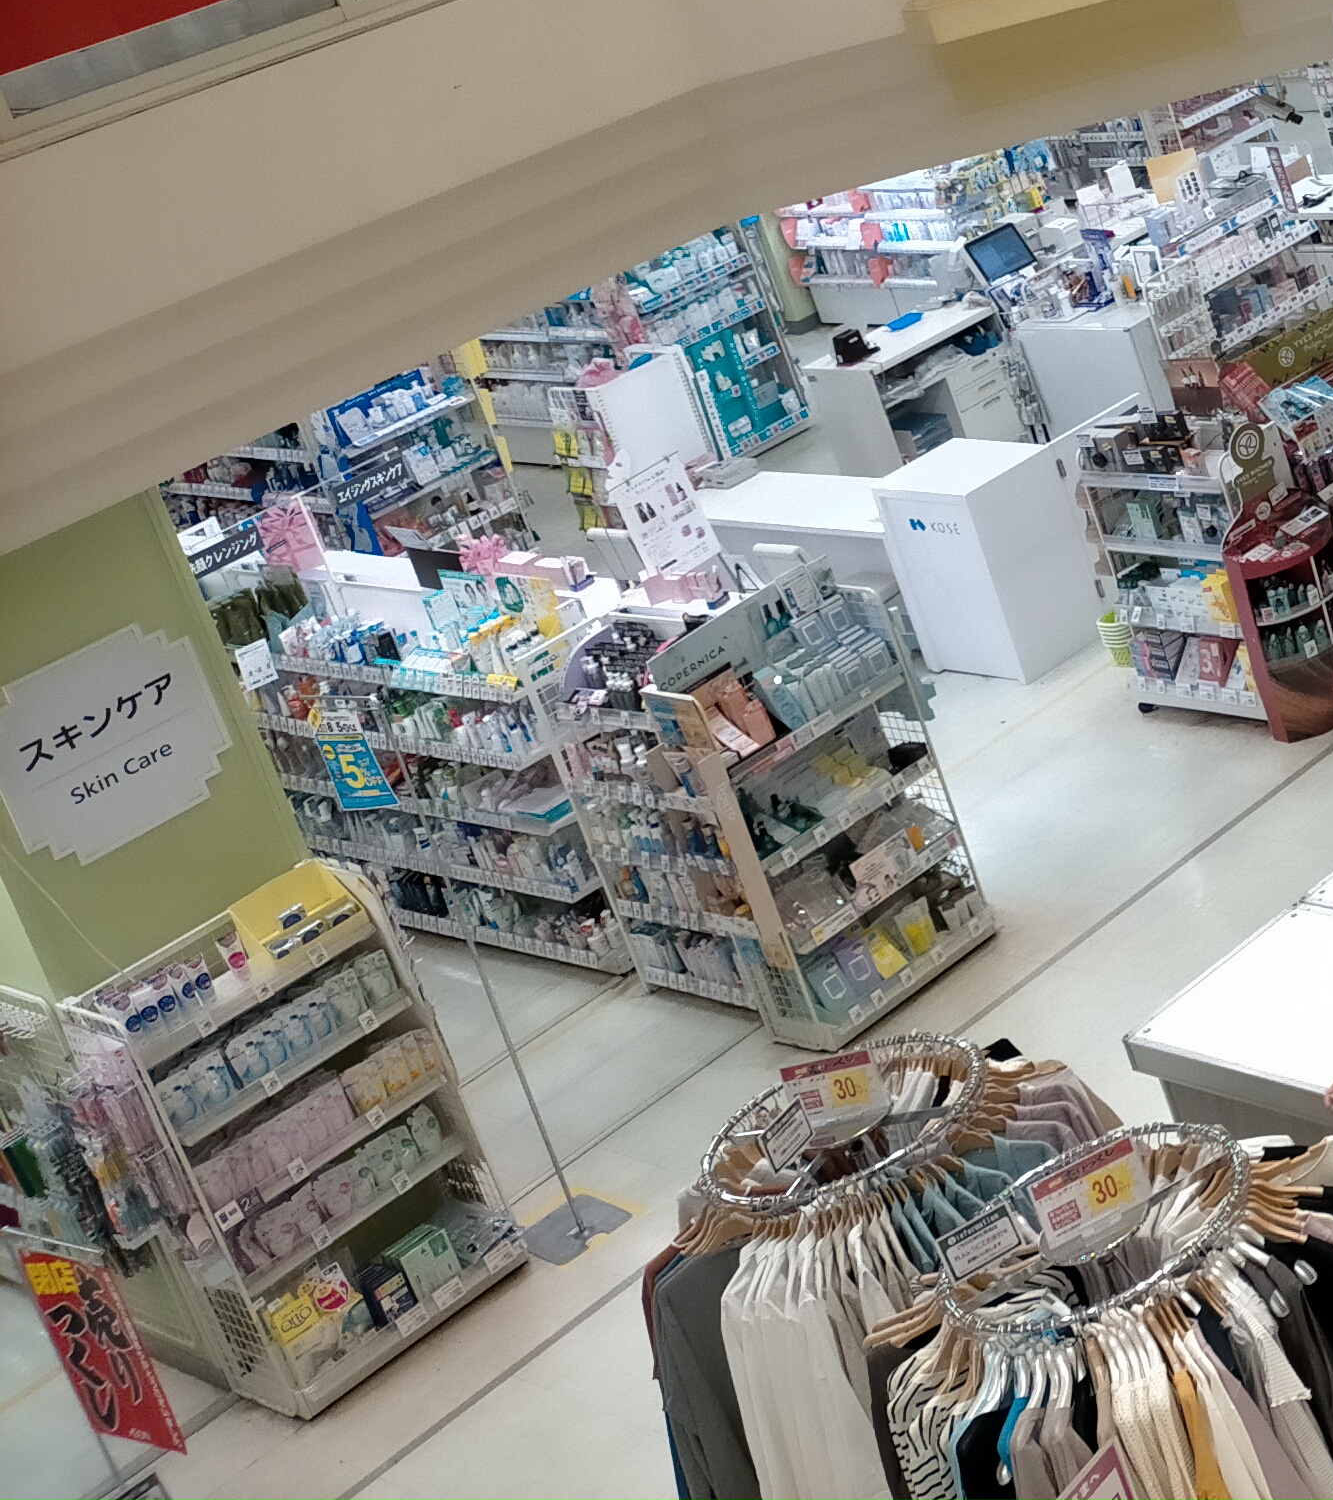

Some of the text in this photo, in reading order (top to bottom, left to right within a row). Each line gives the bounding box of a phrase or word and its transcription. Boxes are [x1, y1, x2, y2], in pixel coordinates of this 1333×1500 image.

[658, 643, 727, 693] COPERNICA
[19, 672, 173, 773] スキンケア
[69, 738, 175, 806] Skin Care
[833, 1076, 858, 1101] 30
[1091, 1173, 1119, 1206] 30
[24, 1260, 80, 1296] 閉店
[75, 1265, 145, 1407] 売り
[44, 1301, 120, 1434] つくし
